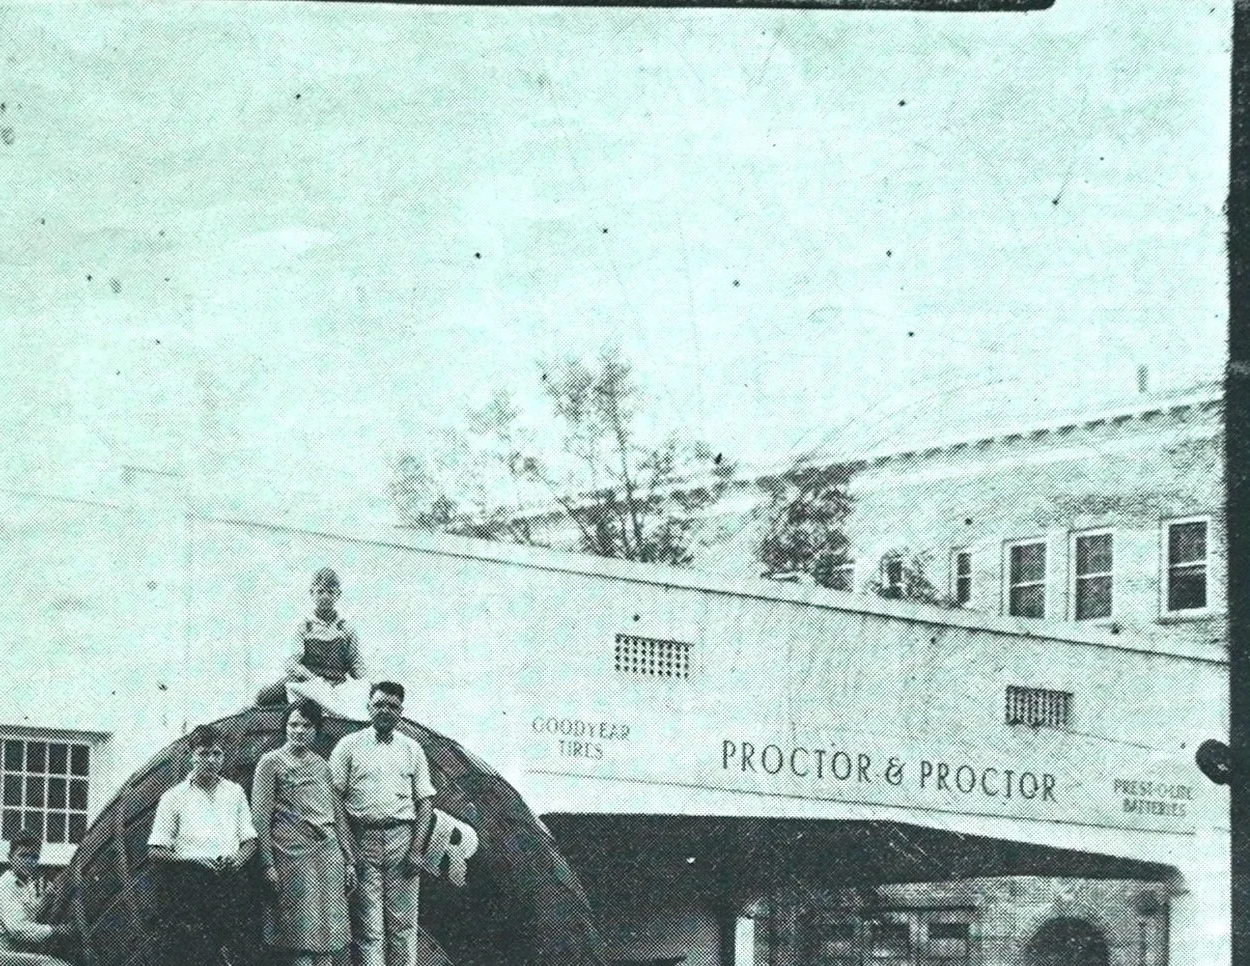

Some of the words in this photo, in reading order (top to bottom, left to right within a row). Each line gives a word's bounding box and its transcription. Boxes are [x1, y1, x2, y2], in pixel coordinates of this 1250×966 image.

[531, 716, 630, 741] GOODYEAR
[558, 738, 604, 761] TIRES
[723, 739, 872, 783] PROCTOR
[884, 756, 907, 786] &
[921, 760, 1057, 803] PROCTOR
[1113, 778, 1195, 801] PREST-O-LITE
[1123, 798, 1187, 818] BATTERIES
